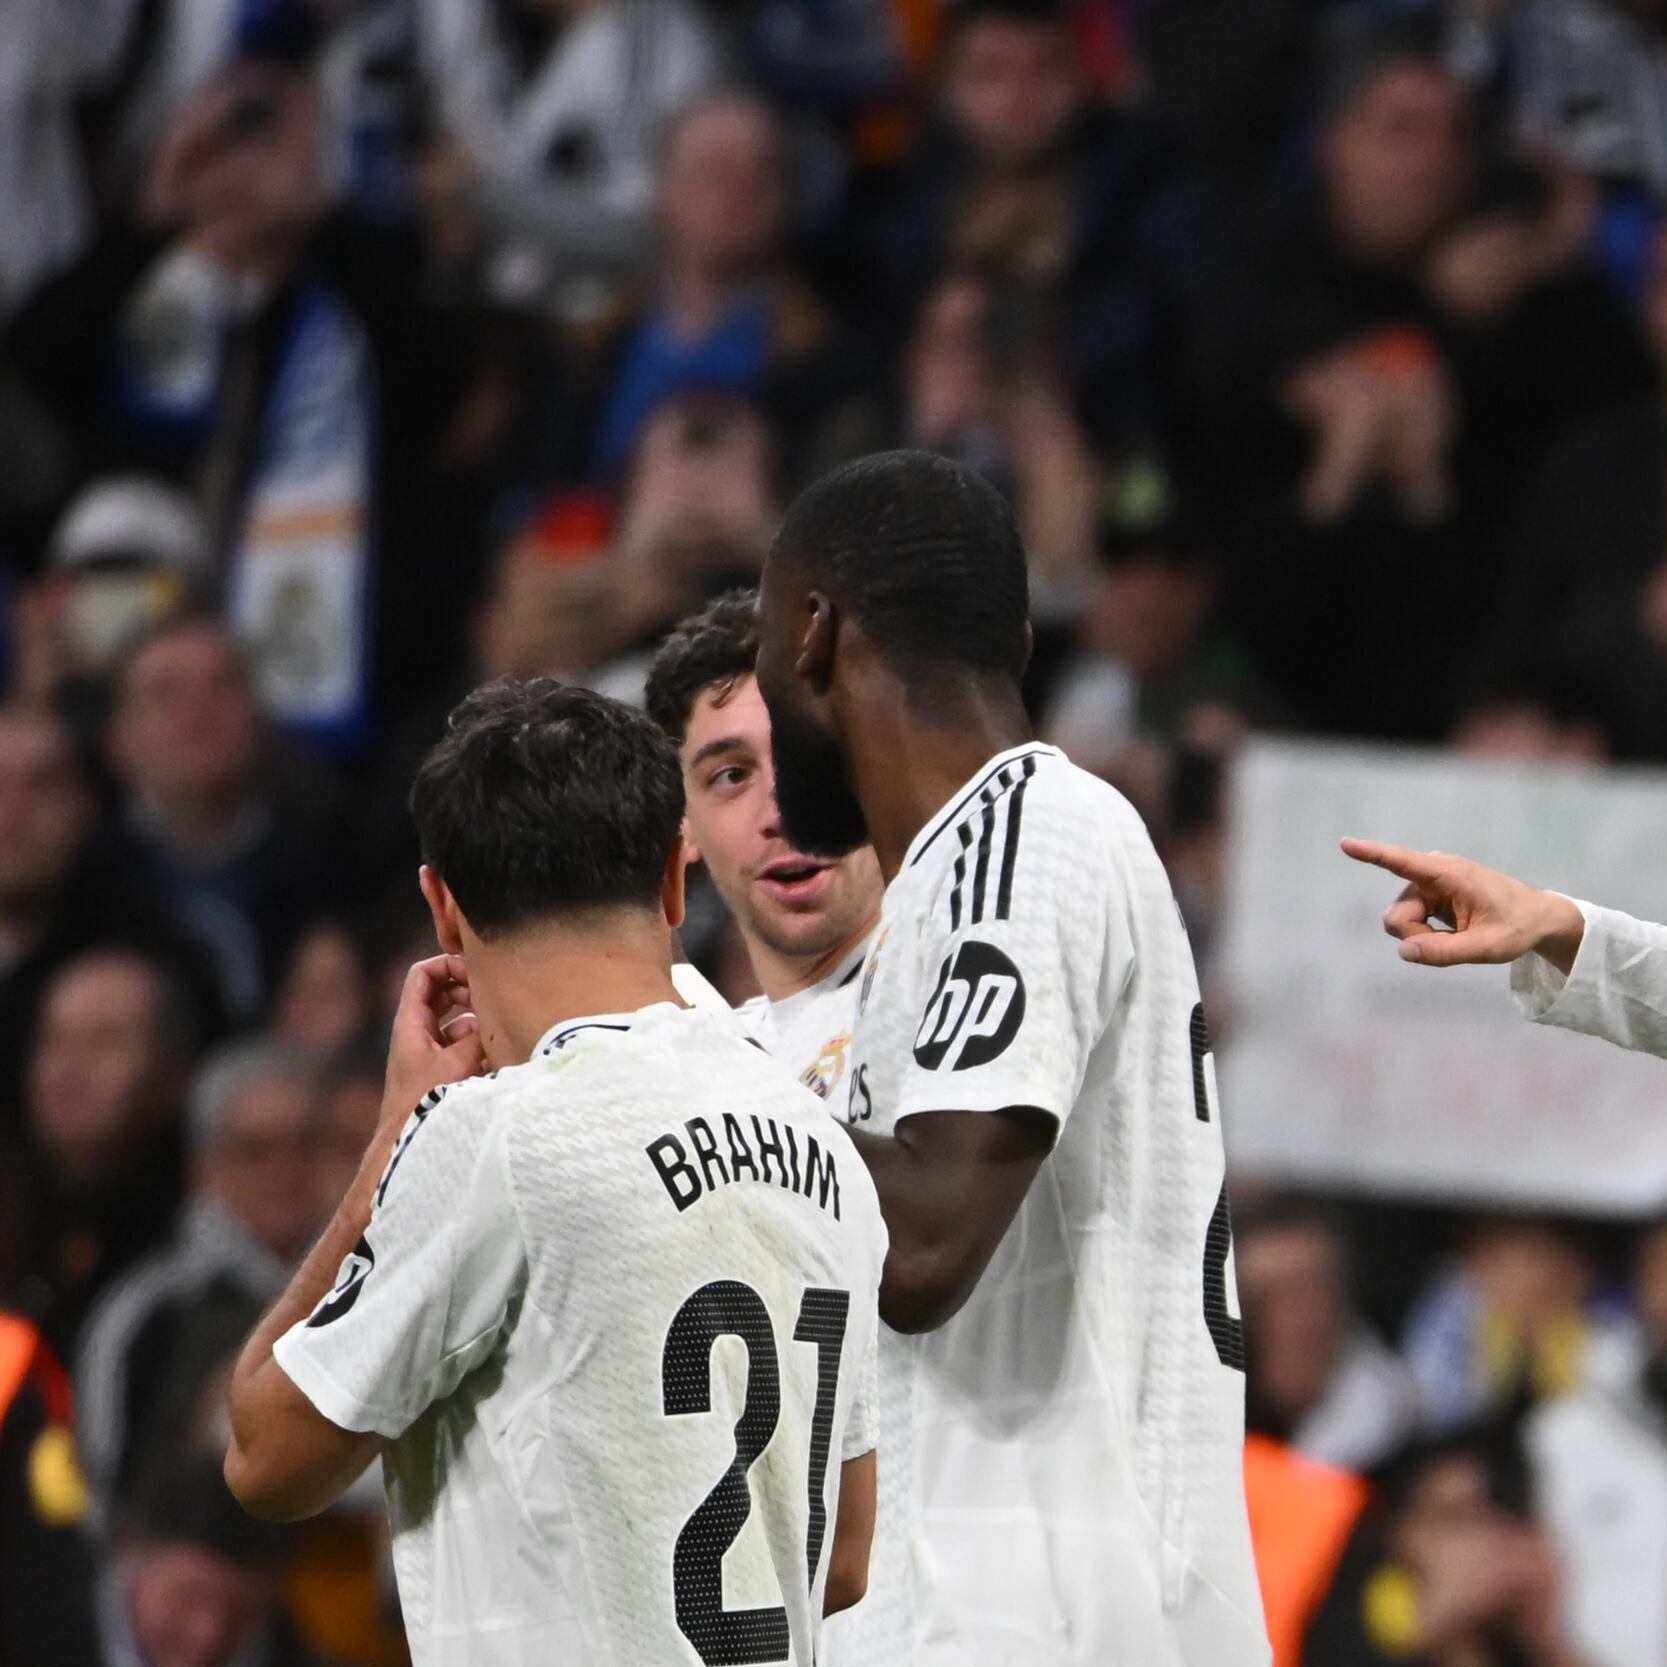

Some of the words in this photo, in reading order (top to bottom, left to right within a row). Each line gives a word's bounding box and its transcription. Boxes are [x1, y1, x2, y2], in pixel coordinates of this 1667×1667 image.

[913, 940, 1027, 1072] hp
[645, 1112, 841, 1223] BRAHIM
[662, 1279, 850, 1667] 21
